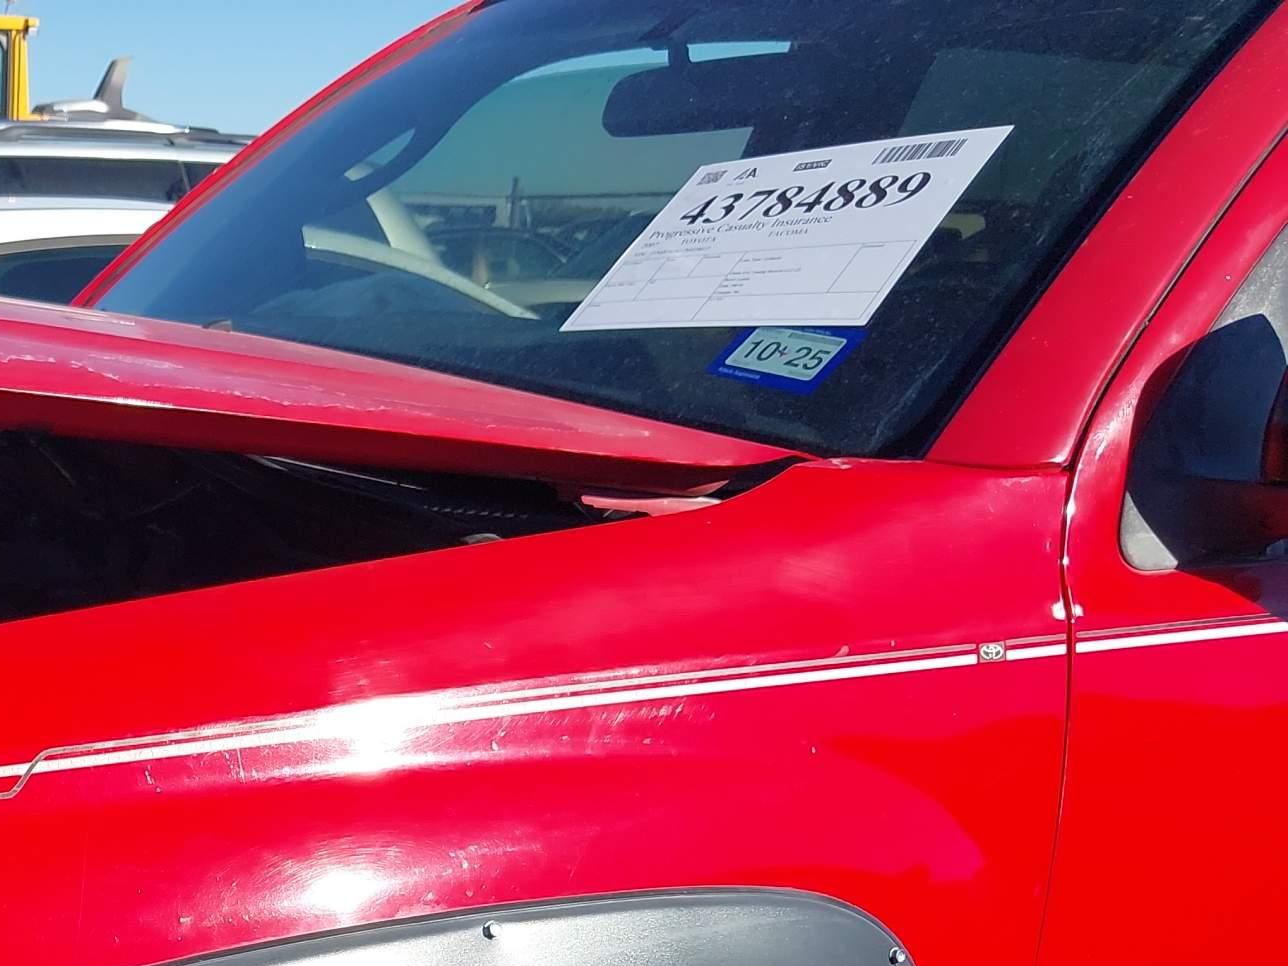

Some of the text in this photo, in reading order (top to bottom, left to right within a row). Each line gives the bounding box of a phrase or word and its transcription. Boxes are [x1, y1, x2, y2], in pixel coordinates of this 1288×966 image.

[679, 172, 931, 226] 43784889
[648, 215, 833, 240] Progressive Casualty Insurance
[783, 346, 832, 370] 25
